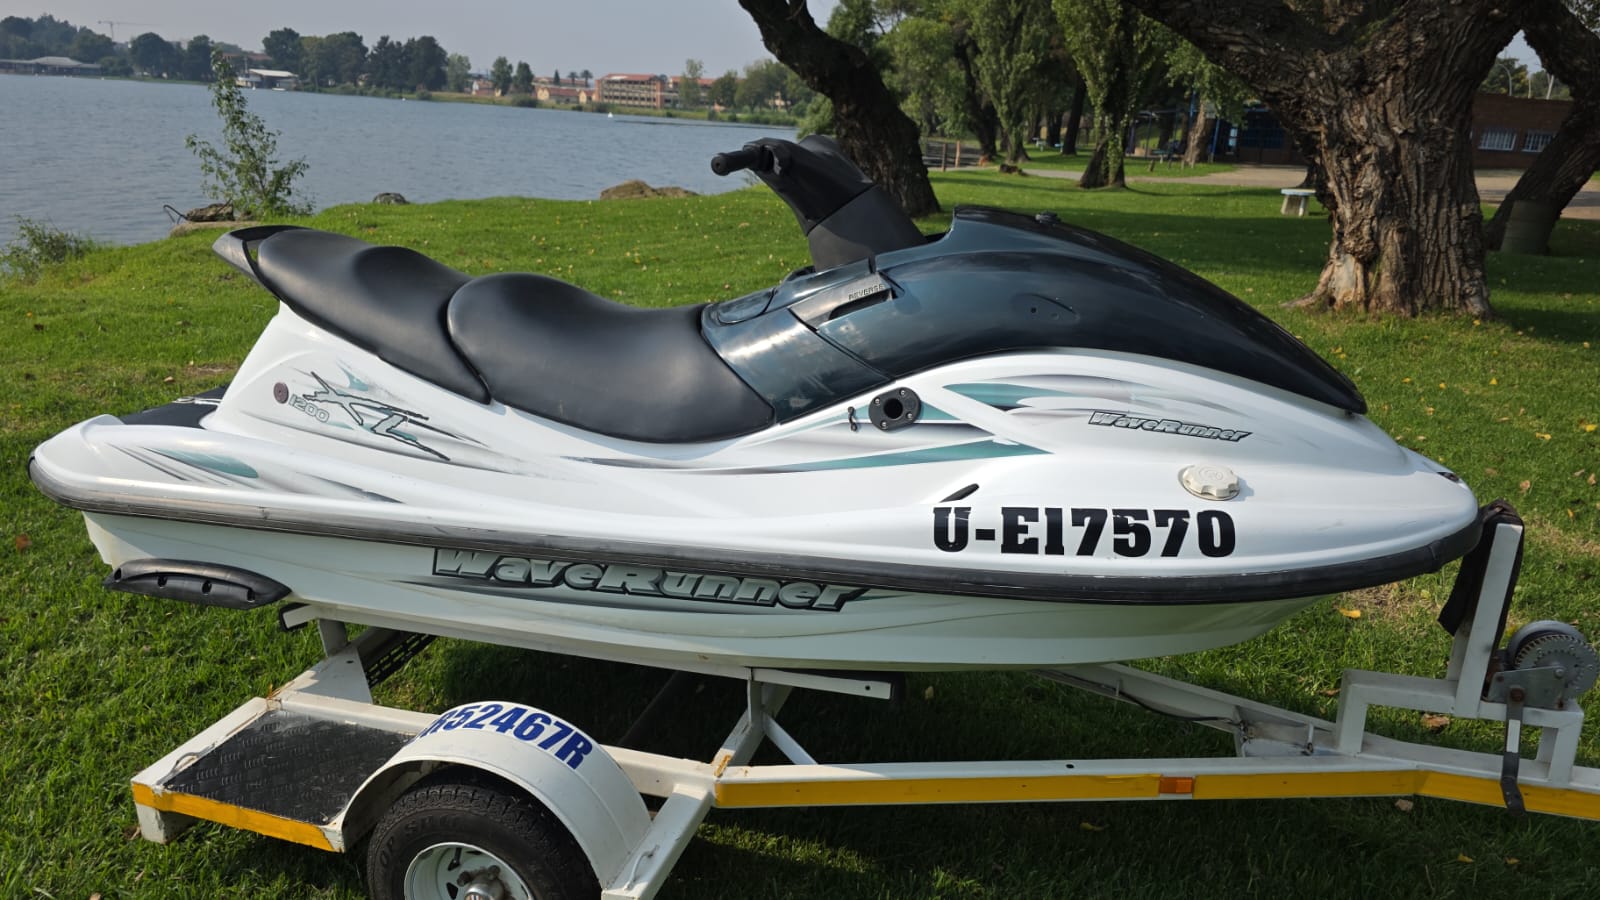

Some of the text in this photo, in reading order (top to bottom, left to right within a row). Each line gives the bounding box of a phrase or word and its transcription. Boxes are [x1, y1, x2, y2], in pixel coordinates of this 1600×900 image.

[848, 283, 886, 301] REVERSE
[288, 393, 330, 423] 1200
[1088, 410, 1254, 442] WaveRunner
[933, 506, 1236, 558] U-E17570
[432, 547, 866, 612] WaveRunner
[412, 703, 594, 770] R52467R
